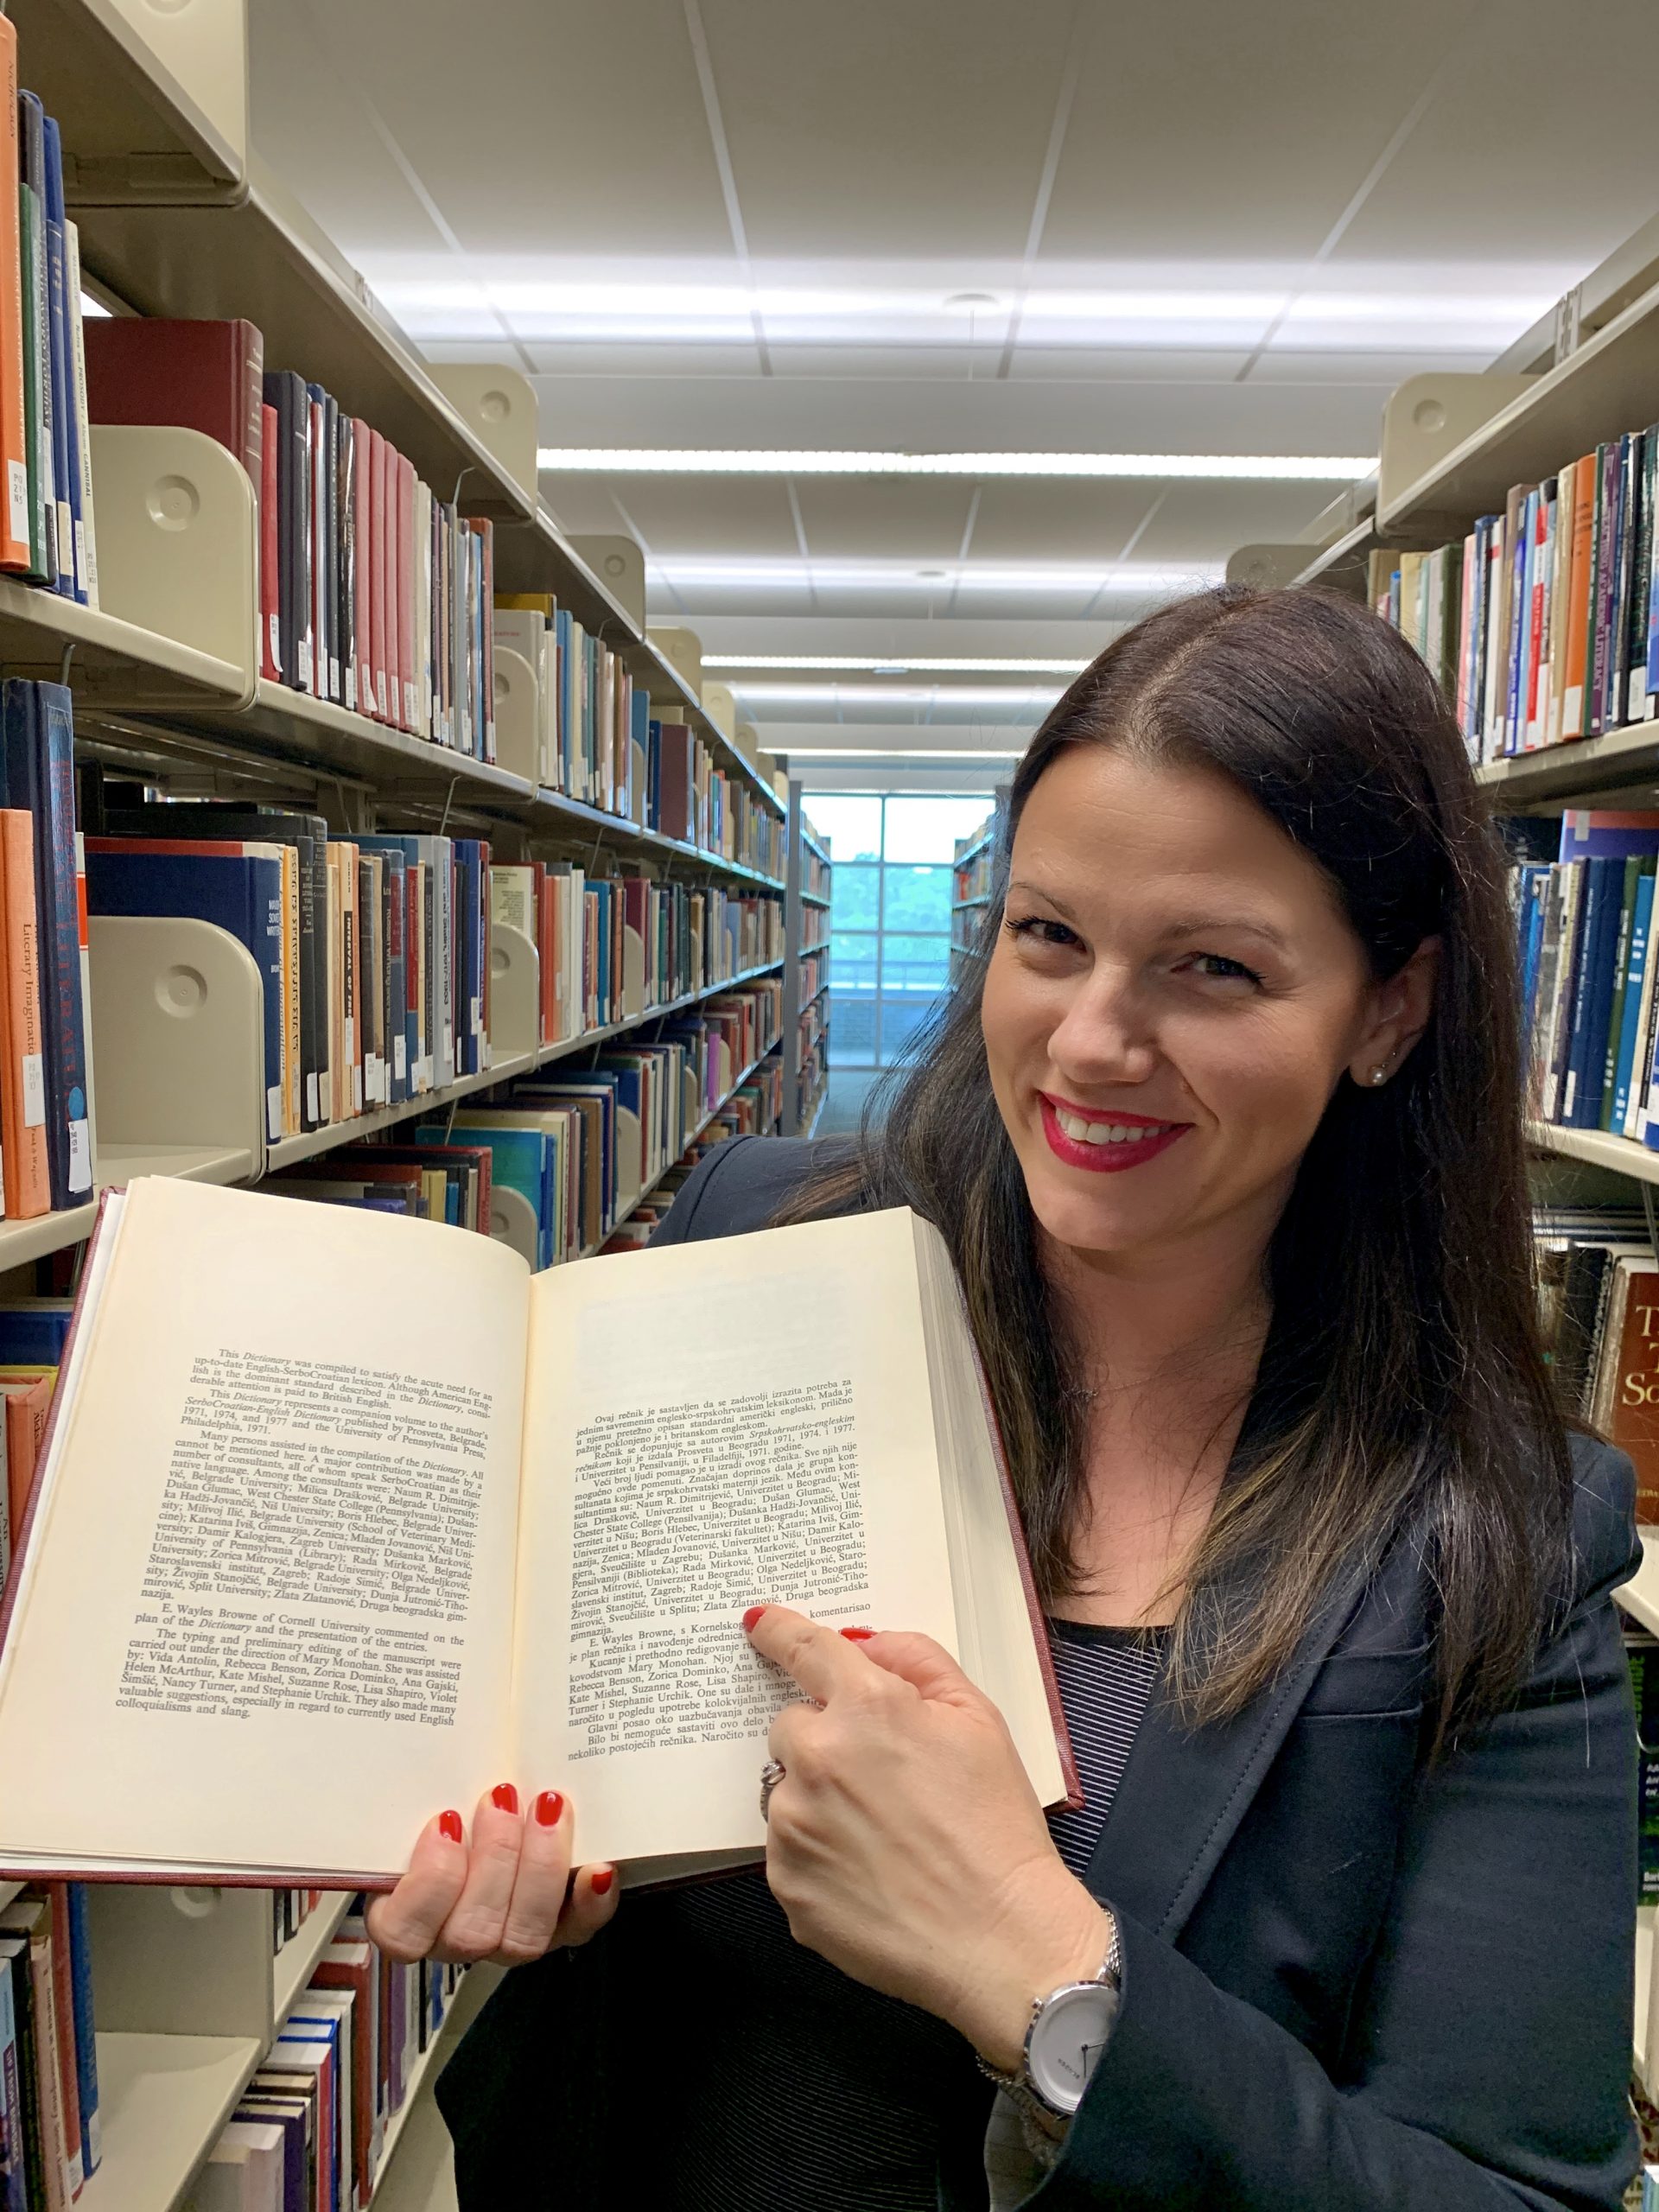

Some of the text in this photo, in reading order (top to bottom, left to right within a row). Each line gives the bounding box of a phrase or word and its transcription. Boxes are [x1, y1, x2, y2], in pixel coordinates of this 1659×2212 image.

[22, 924, 36, 1056] Literary Imaginatio
[347, 975, 353, 992] OF
[189, 1376, 392, 1409] derable attention is paid to British English.
[192, 1364, 491, 1421] lish is the dominant standard described in the Dictionary, consi-
[194, 1357, 492, 1413] up-to-date English-SerboCroatian lexicon. Although American Eng-
[219, 1348, 493, 1402] This Dictionary was compiled to satisfy the acute need for an
[576, 1386, 853, 1438] jednim savremenim englesko-srpskohrvatskim leksikonom. Mada je
[586, 1433, 613, 1445] njemu
[657, 1422, 685, 1434] opisan
[690, 1415, 735, 1428] standardni
[779, 1402, 817, 1416] engleski,
[594, 1414, 614, 1425] Ovaj
[646, 1408, 656, 1418] je
[658, 1402, 700, 1414] sastavljen
[702, 1400, 715, 1409] da
[730, 1392, 769, 1406] zadovolji
[772, 1388, 803, 1399] izrazita
[805, 1381, 839, 1395] potreba
[603, 1436, 652, 1452] poklonjeno
[653, 1433, 662, 1444] je
[664, 1432, 668, 1441] i
[670, 1428, 720, 1440] britanskom
[721, 1421, 768, 1434] engleskom.
[162, 1602, 465, 1646] E. Wayles Browne of Cornell University commented on the
[588, 1638, 600, 1648] E.
[601, 1633, 633, 1645] Wayles
[638, 1629, 677, 1641] Browne,
[690, 1620, 746, 1634] Kornelskog
[809, 1601, 870, 1618] komentarisao
[569, 1654, 578, 1664] je
[581, 1649, 601, 1662] plan
[639, 1642, 644, 1650] i
[697, 1631, 747, 1643] odrednica.
[115, 1699, 251, 1719] colloquialisms and slang.
[587, 1722, 619, 1734] Glavni
[622, 1719, 651, 1732] posao
[654, 1715, 674, 1725] oko
[747, 1704, 782, 1715] obavila
[568, 1747, 607, 1761] nekoliko
[7, 2069, 16, 2105] FROM
